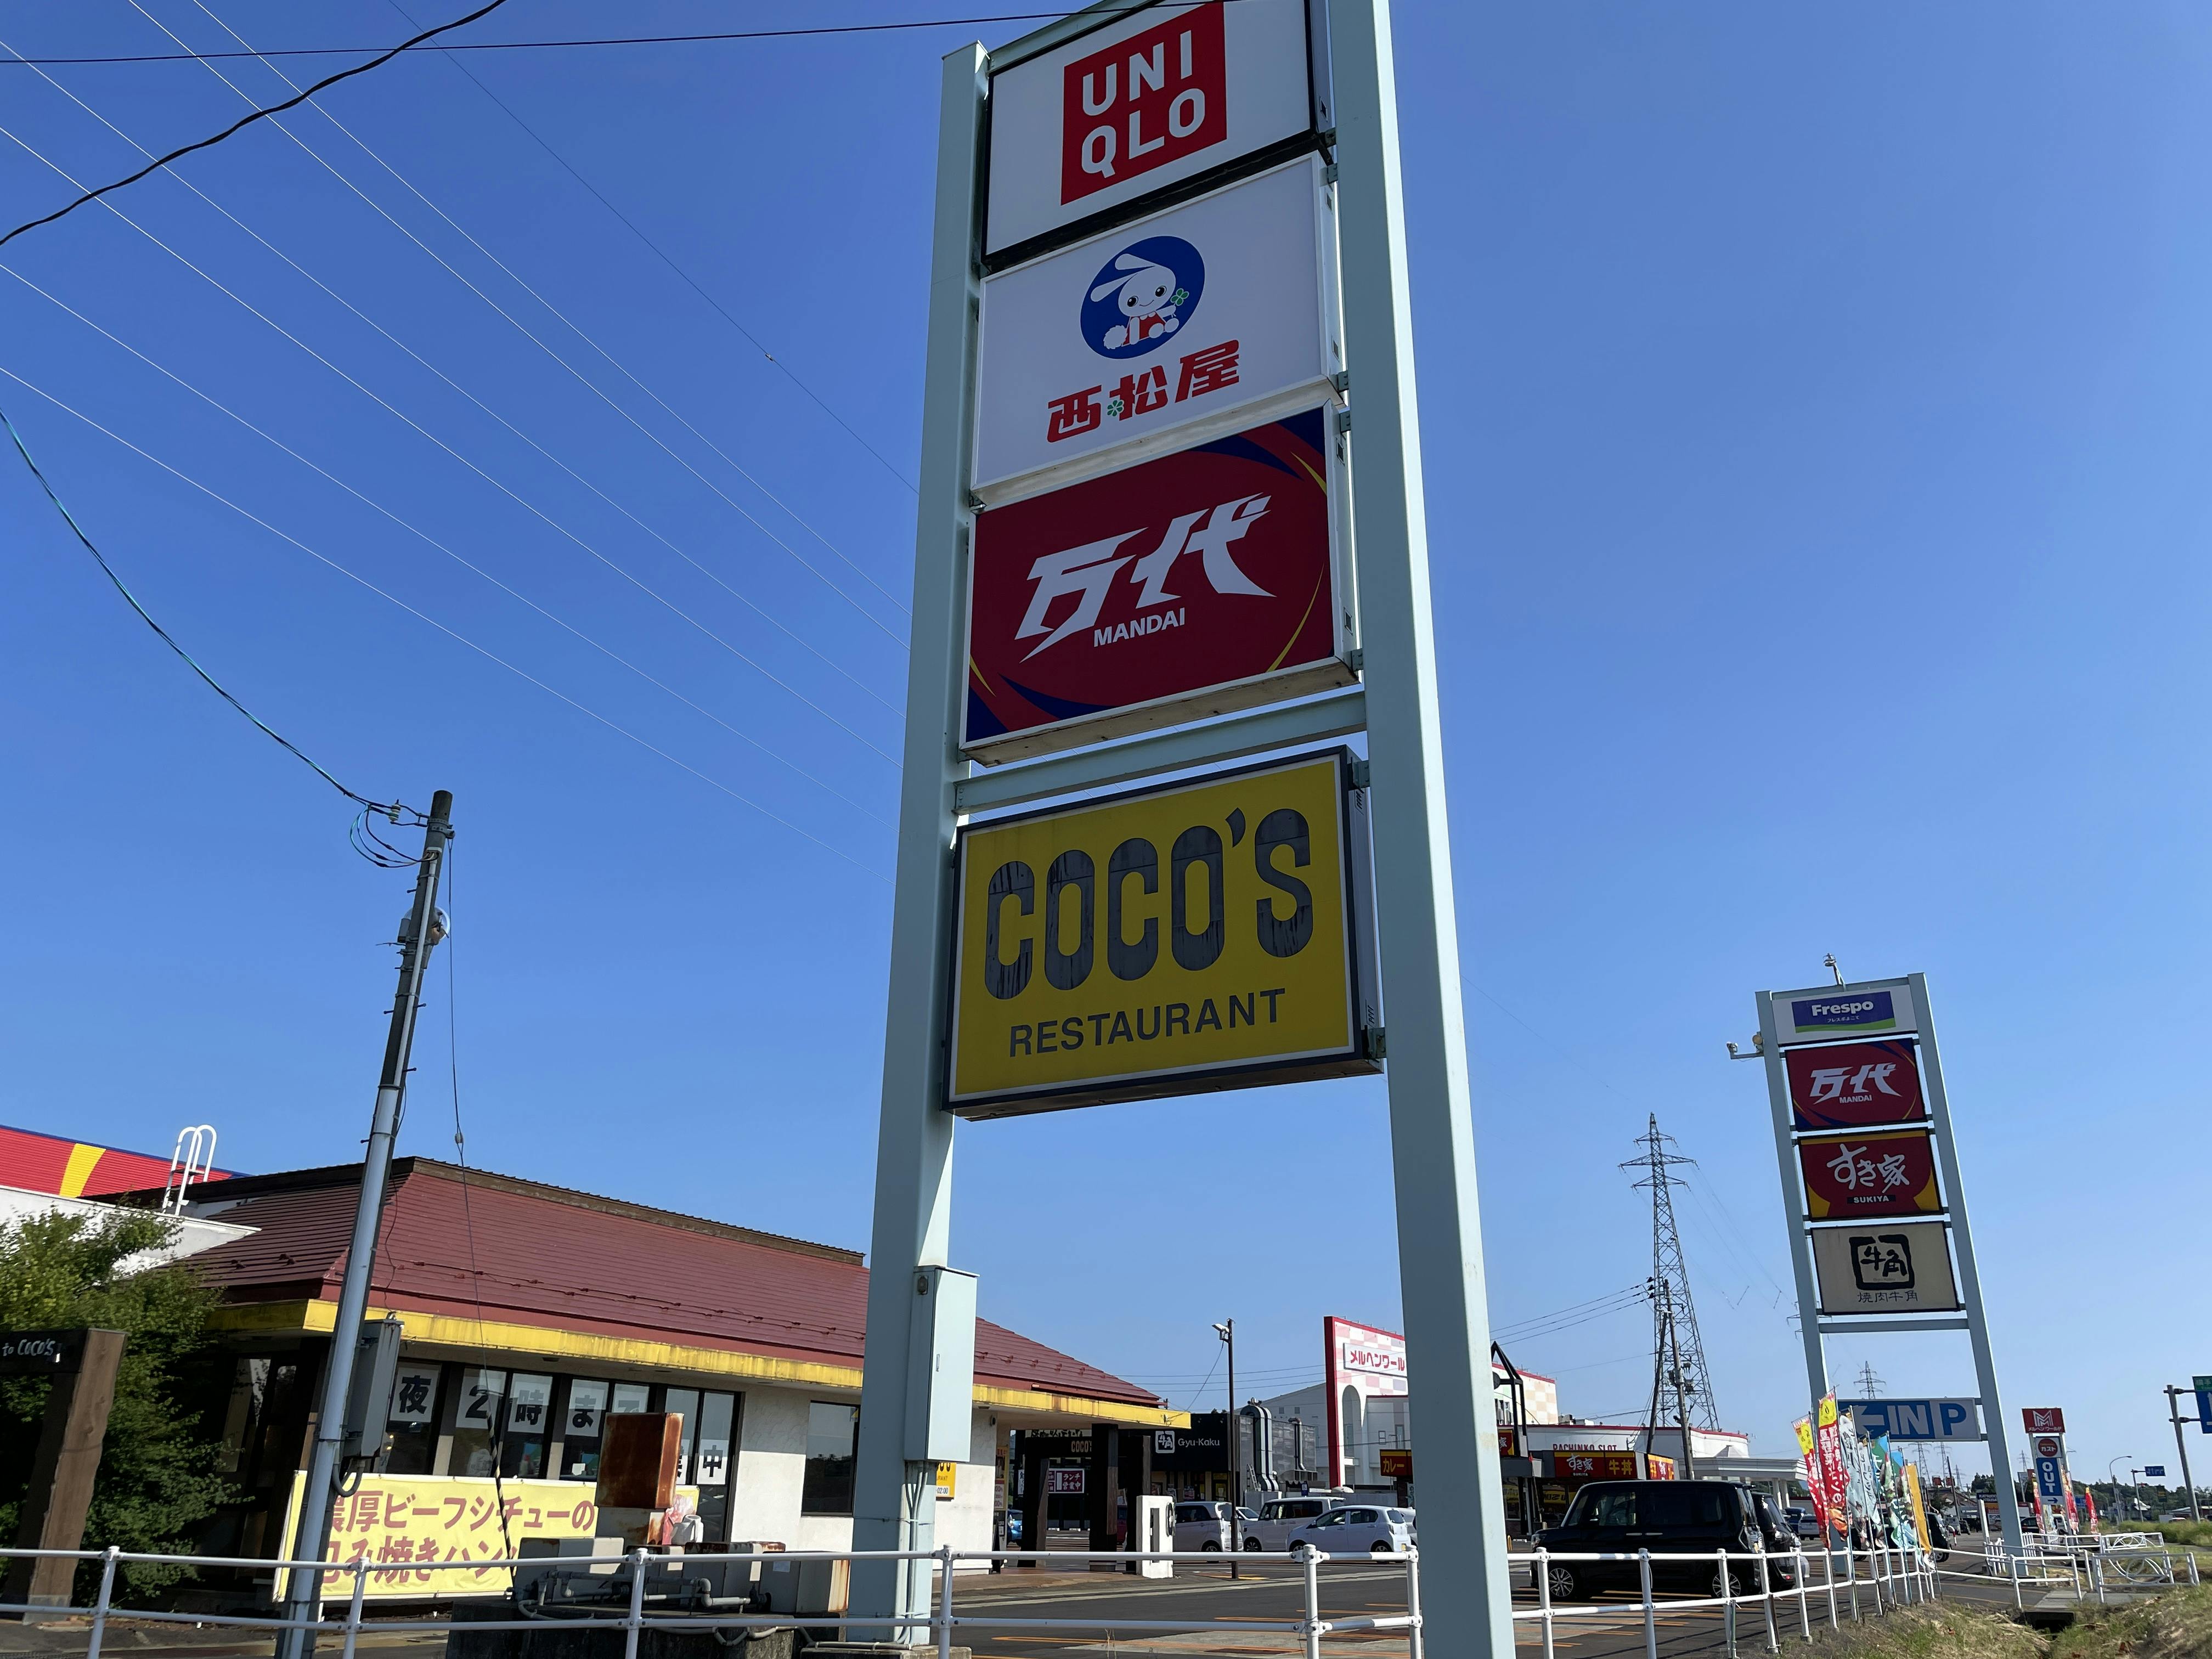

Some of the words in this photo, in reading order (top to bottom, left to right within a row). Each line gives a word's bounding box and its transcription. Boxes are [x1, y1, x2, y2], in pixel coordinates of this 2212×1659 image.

[1082, 30, 1193, 116] UNI
[1081, 88, 1205, 178] QLO
[1047, 338, 1239, 443] 西松屋
[1014, 492, 1277, 664] 万代
[1093, 607, 1186, 648] MANDAI
[984, 807, 1313, 1000] COCO'S
[1009, 988, 1286, 1057] RESTAURANT
[1812, 1001, 1874, 1016] Frespo
[1809, 1063, 1903, 1105] 万代
[1839, 1094, 1872, 1103] MANDAI
[1827, 1143, 1910, 1193] すき家
[1853, 1195, 1890, 1204] SUKIYA
[1860, 1246, 1908, 1277] 牛角
[1857, 1290, 1918, 1303] 焼肉牛角
[2, 1342, 15, 1356] to
[1887, 1404, 1930, 1435] IN
[1939, 1403, 1967, 1436] P
[1178, 1438, 1220, 1447] Gyu-Kaku
[1063, 1472, 1081, 1481] ランチ
[1383, 1457, 1404, 1473] カレー
[1566, 1453, 1594, 1472] すき家
[1609, 1459, 1633, 1475] 牛丼
[2042, 1462, 2056, 1493] OUT
